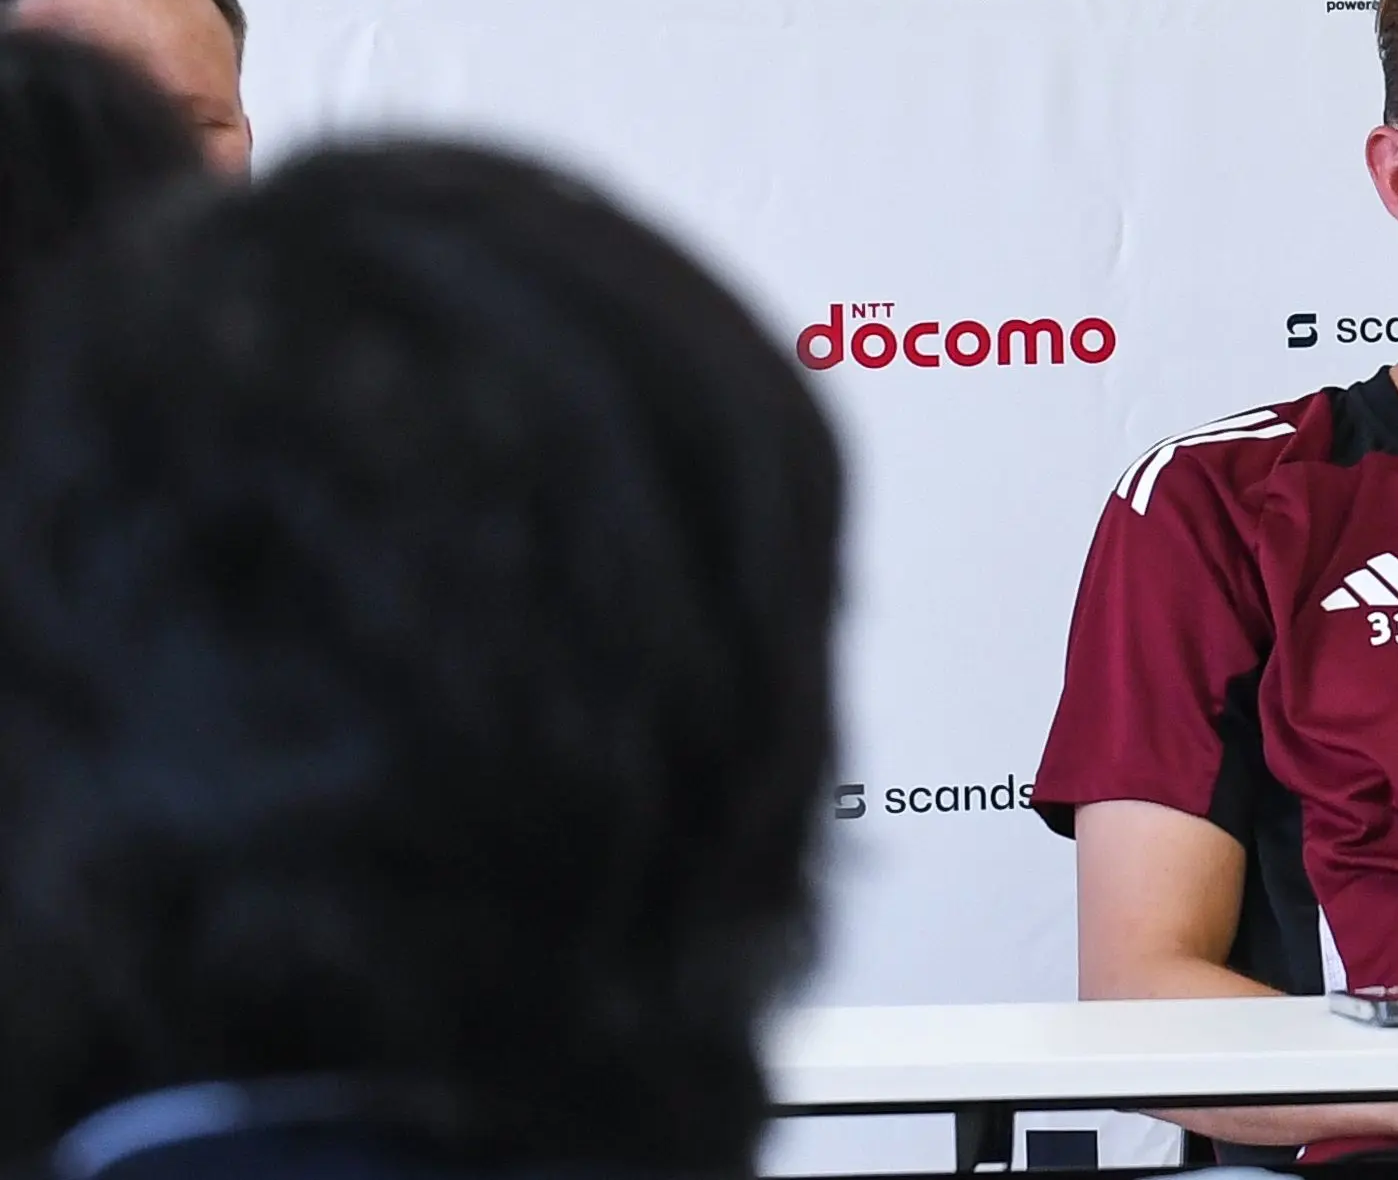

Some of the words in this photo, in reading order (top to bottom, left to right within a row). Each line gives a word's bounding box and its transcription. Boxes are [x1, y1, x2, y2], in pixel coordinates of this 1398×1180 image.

[852, 302, 895, 319] NTT
[796, 302, 1116, 370] docomo
[885, 773, 1036, 814] scands
